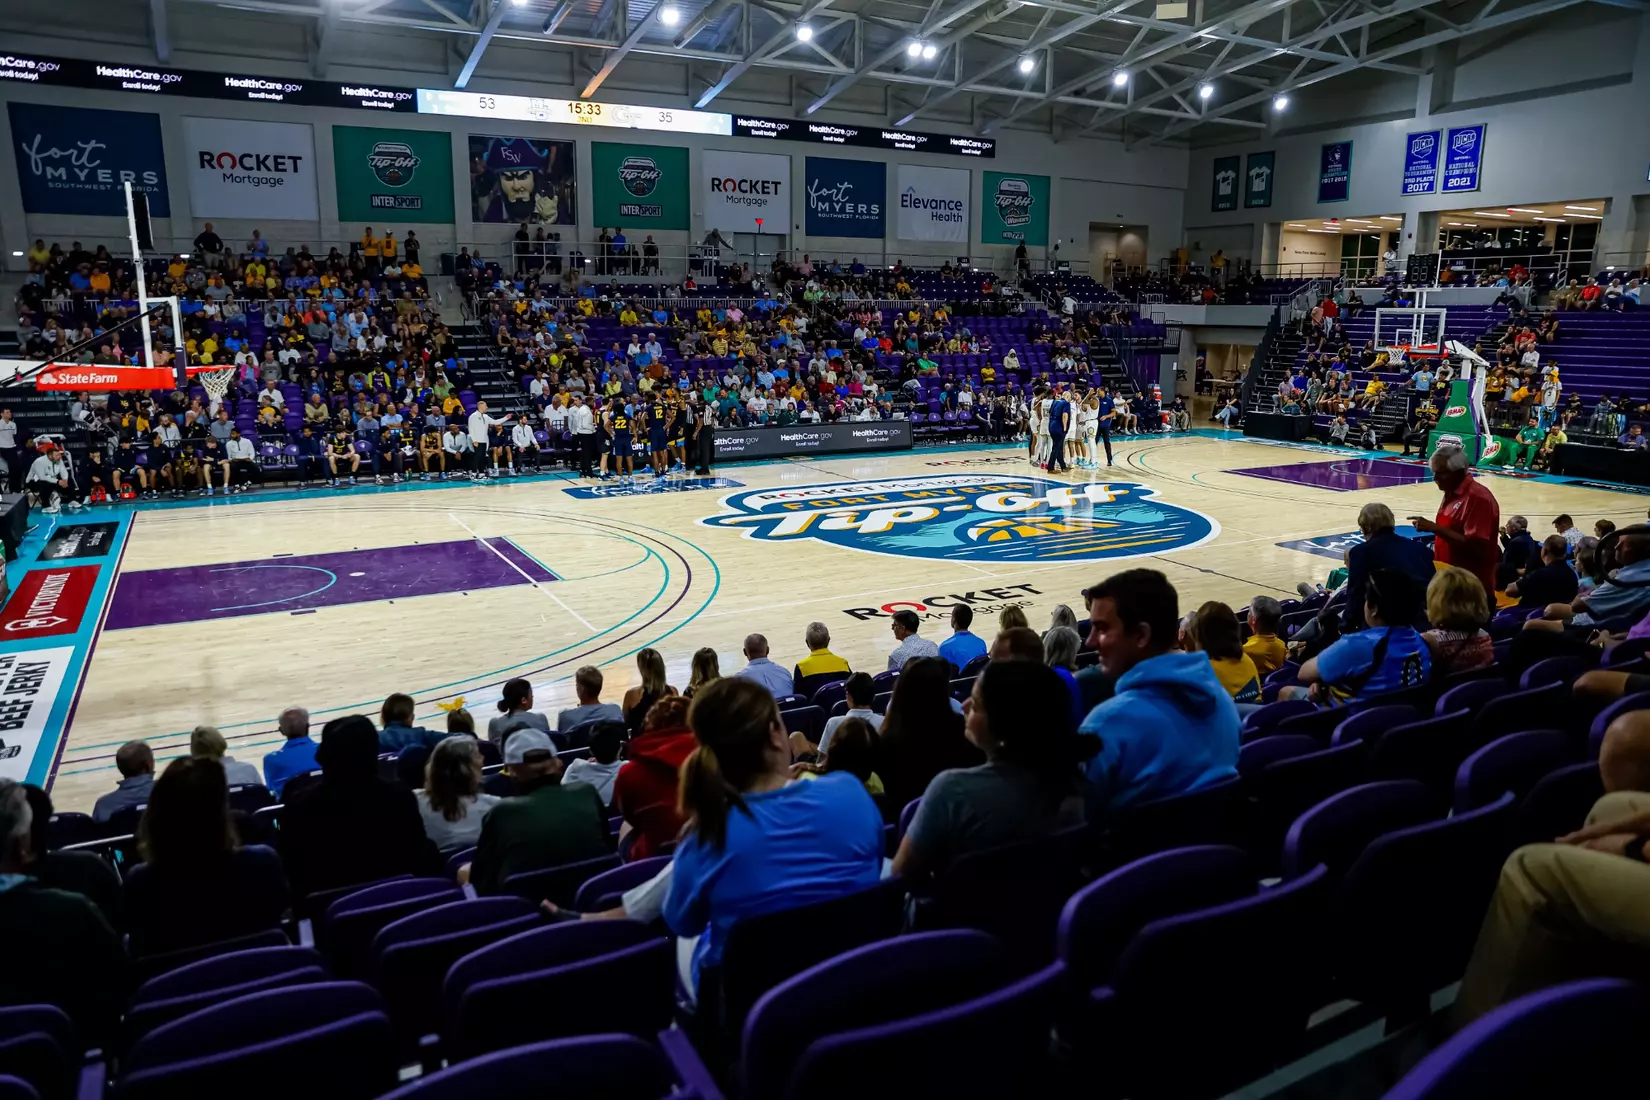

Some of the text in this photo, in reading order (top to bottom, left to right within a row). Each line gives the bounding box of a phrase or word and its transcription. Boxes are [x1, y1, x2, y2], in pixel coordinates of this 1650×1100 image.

[96, 65, 182, 83] HealthCare.gov
[122, 81, 141, 89] Enroll
[225, 77, 302, 92] HealthCare.gov
[341, 86, 412, 101] HealthCare.gov
[479, 97, 496, 109] 53
[568, 103, 601, 115] 15:33
[658, 112, 673, 123] 35
[737, 118, 789, 130] HealthCare.gov
[809, 124, 858, 137] HealthCare.gov
[882, 131, 928, 143] HealthCare.gov
[950, 137, 993, 149] HealthCare.gov
[22, 133, 106, 175] fort
[198, 150, 303, 173] ROCKET
[369, 155, 417, 168] Tip-Off
[45, 166, 159, 185] MYERS
[222, 172, 284, 188] Mortgage
[619, 168, 659, 181] Tip-Off
[48, 181, 112, 190] SOUTHWEST
[711, 177, 782, 195] ROCKET
[1407, 182, 1429, 192] 2017
[1447, 176, 1471, 188] 2021
[807, 178, 853, 209] fort
[726, 195, 768, 208] Mortgage
[901, 193, 963, 211] Elevance
[995, 194, 1031, 207] Tip-Off
[817, 201, 880, 215] MYERS
[931, 211, 963, 223] Health
[655, 409, 663, 419] 12
[614, 419, 627, 429] 22
[780, 432, 833, 442] HealthCare.gov
[852, 428, 901, 438] HealthCare.gov
[714, 436, 759, 447] althCare.gov
[759, 484, 876, 501] ROCKET
[782, 482, 1035, 511] FORT MYERS
[718, 484, 1130, 537] Tip-Off
[25, 572, 71, 618] VICTORINOX
[842, 583, 1044, 621] ROCKET
[3, 660, 51, 697] JERKY
[0, 699, 34, 732] BEEF
